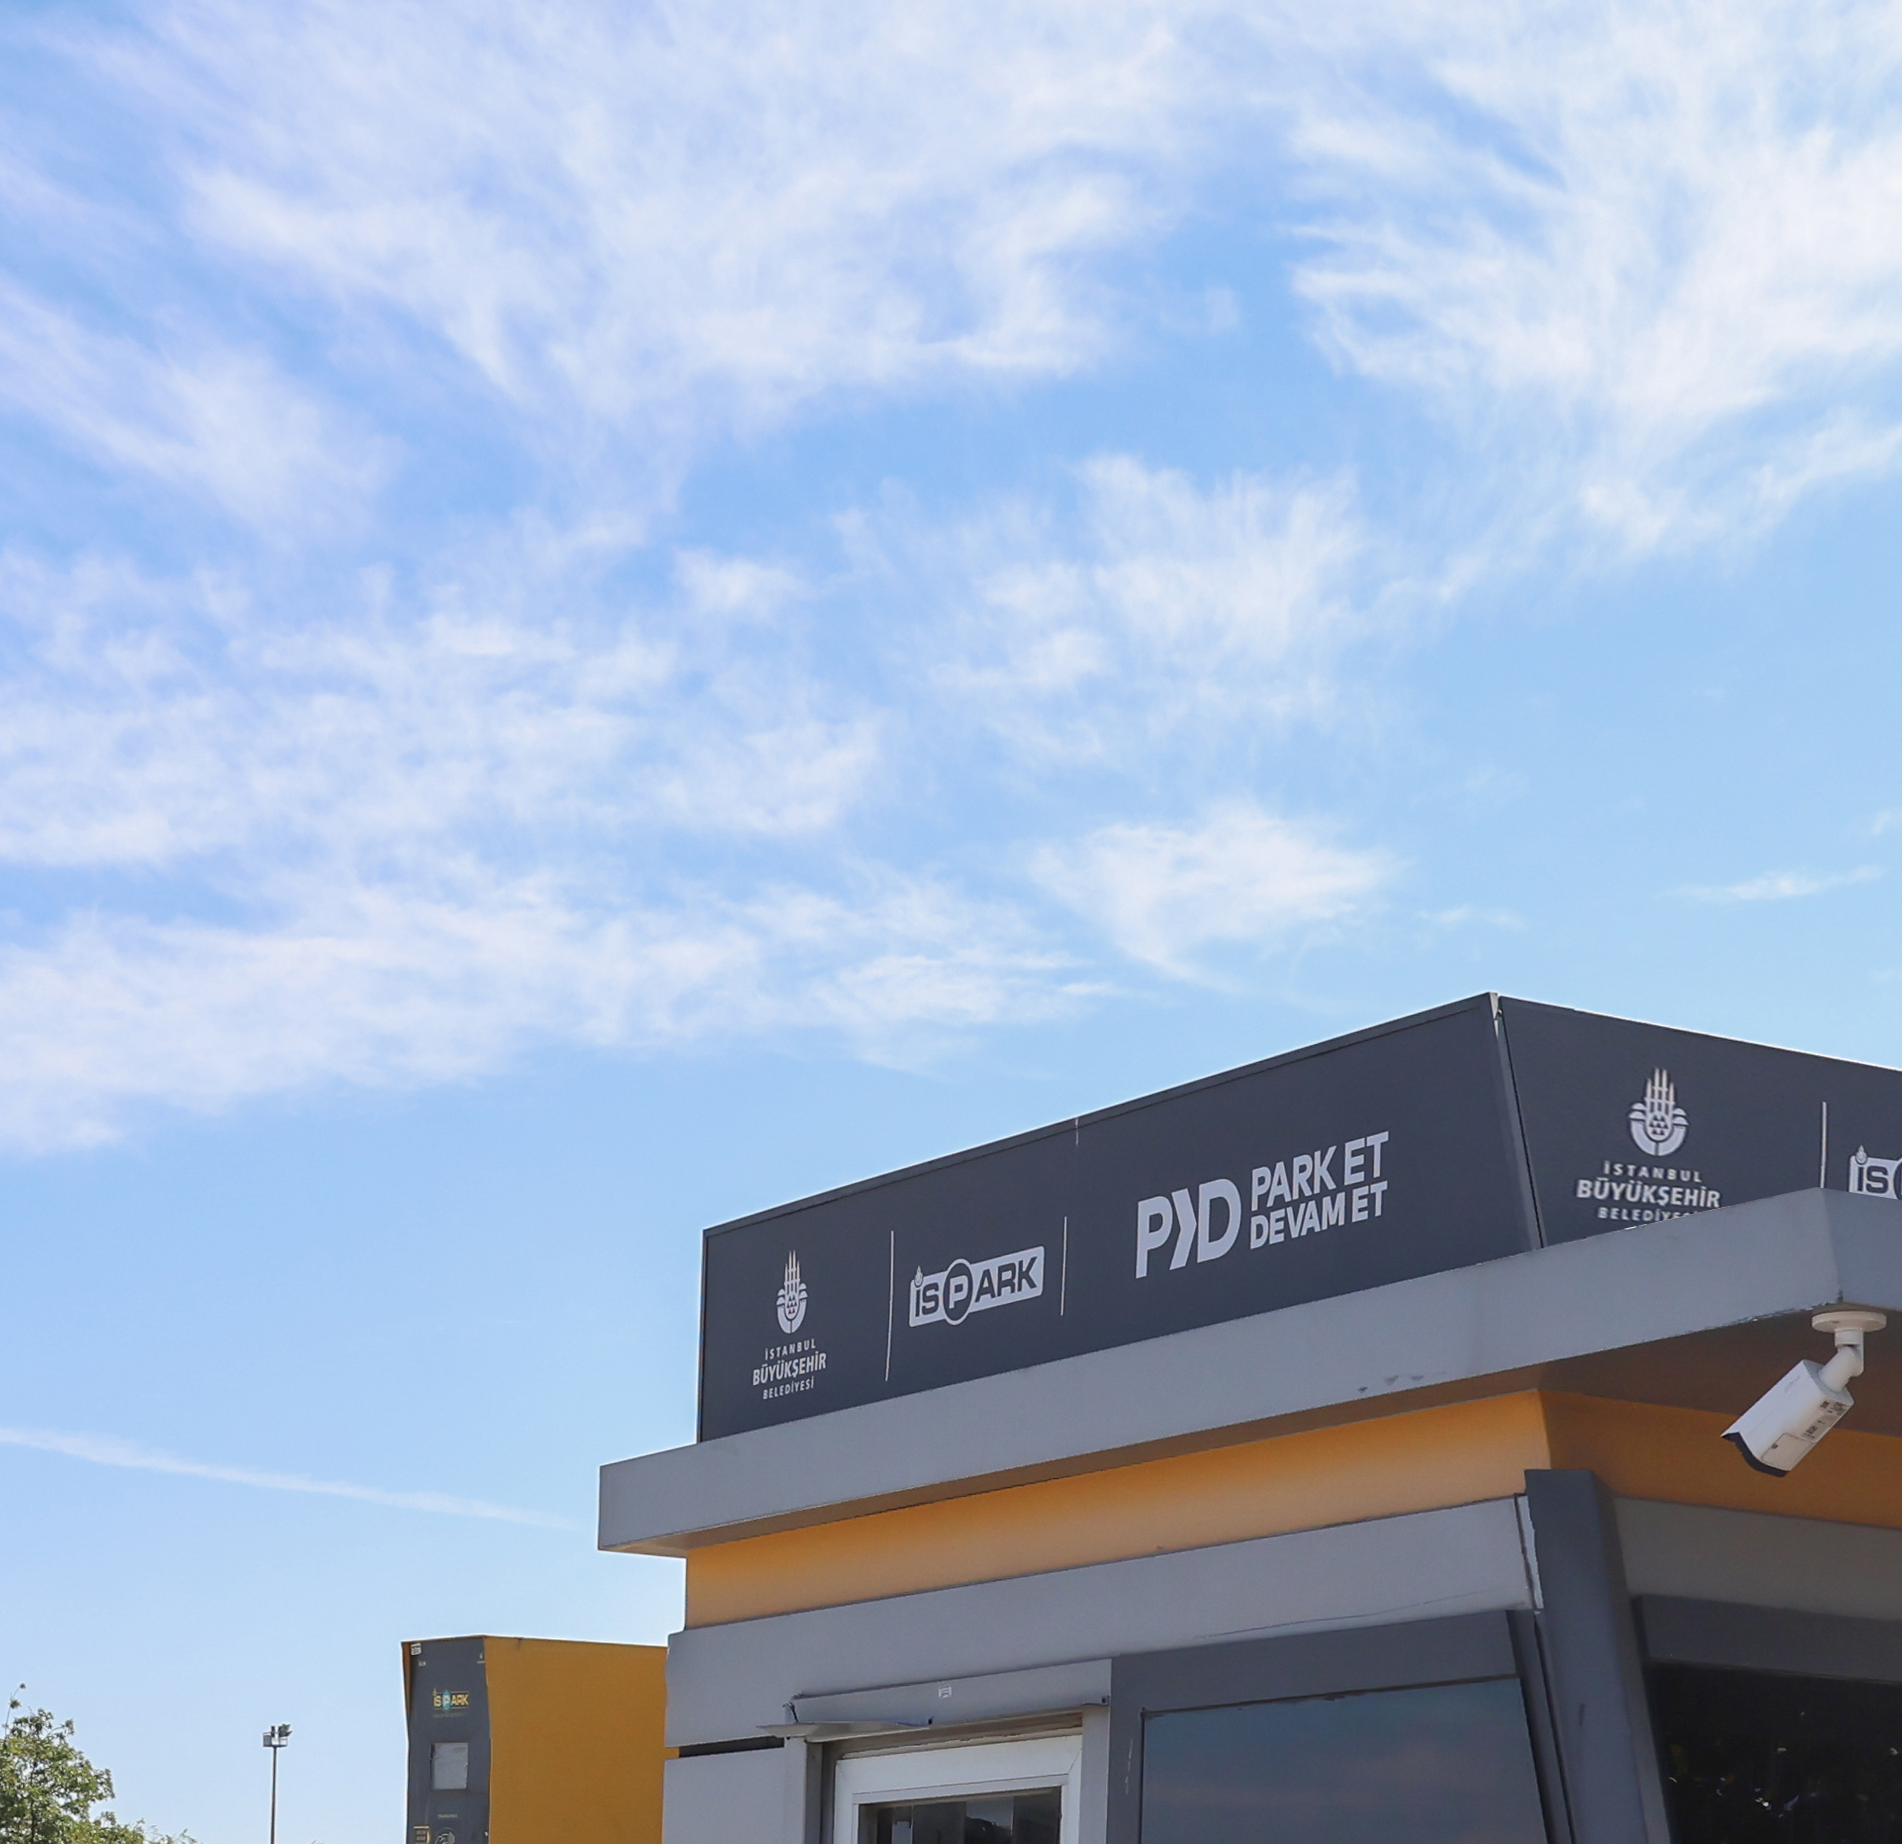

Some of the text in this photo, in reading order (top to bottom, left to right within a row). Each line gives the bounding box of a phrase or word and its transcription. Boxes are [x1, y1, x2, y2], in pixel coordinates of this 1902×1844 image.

[1251, 1131, 1389, 1211] PARK ET
[1604, 1160, 1702, 1183] İSTANBUL
[1577, 1178, 1721, 1208] BÜYÜKŞEHİR
[1250, 1180, 1387, 1250] DEVAM ET
[1598, 1207, 1698, 1221] BELEDİYE
[764, 1339, 817, 1361] İSTANBUL
[753, 1352, 827, 1385] BÜYÜKŞEHİR
[763, 1376, 815, 1399] BELEDİYESİ
